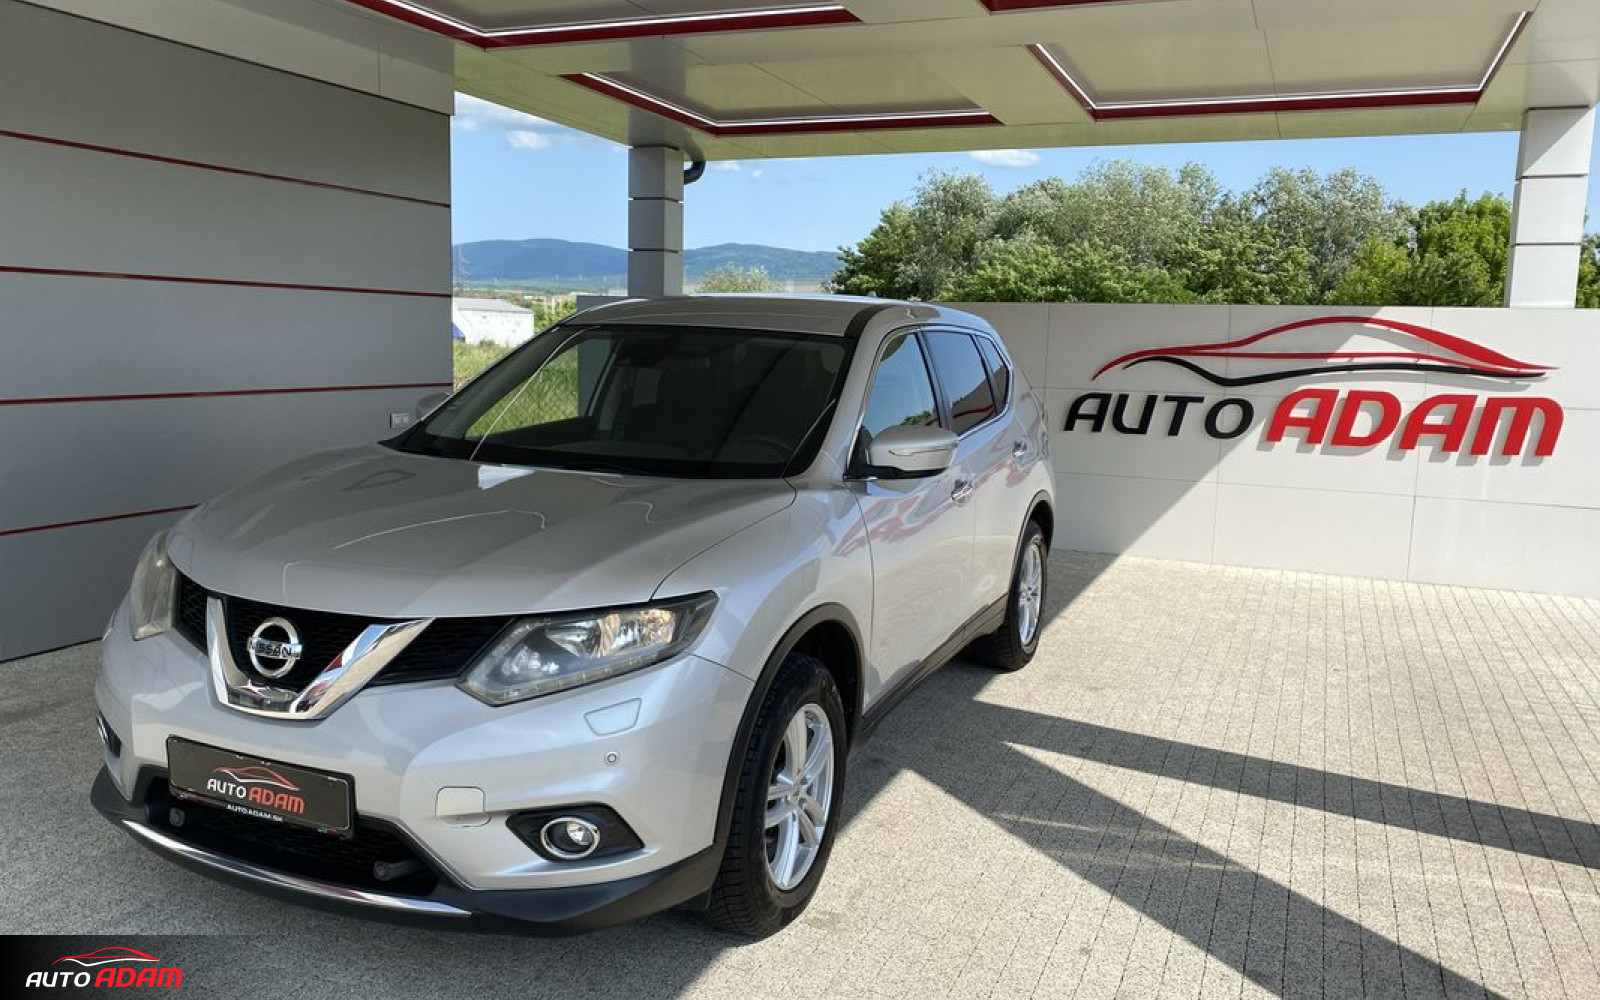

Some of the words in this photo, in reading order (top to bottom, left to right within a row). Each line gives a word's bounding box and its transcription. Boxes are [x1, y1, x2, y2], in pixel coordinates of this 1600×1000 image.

[1063, 392, 1254, 439] AUTO
[1266, 388, 1565, 456] ADAM
[207, 778, 247, 798] AUTO
[249, 787, 304, 814] ADAM
